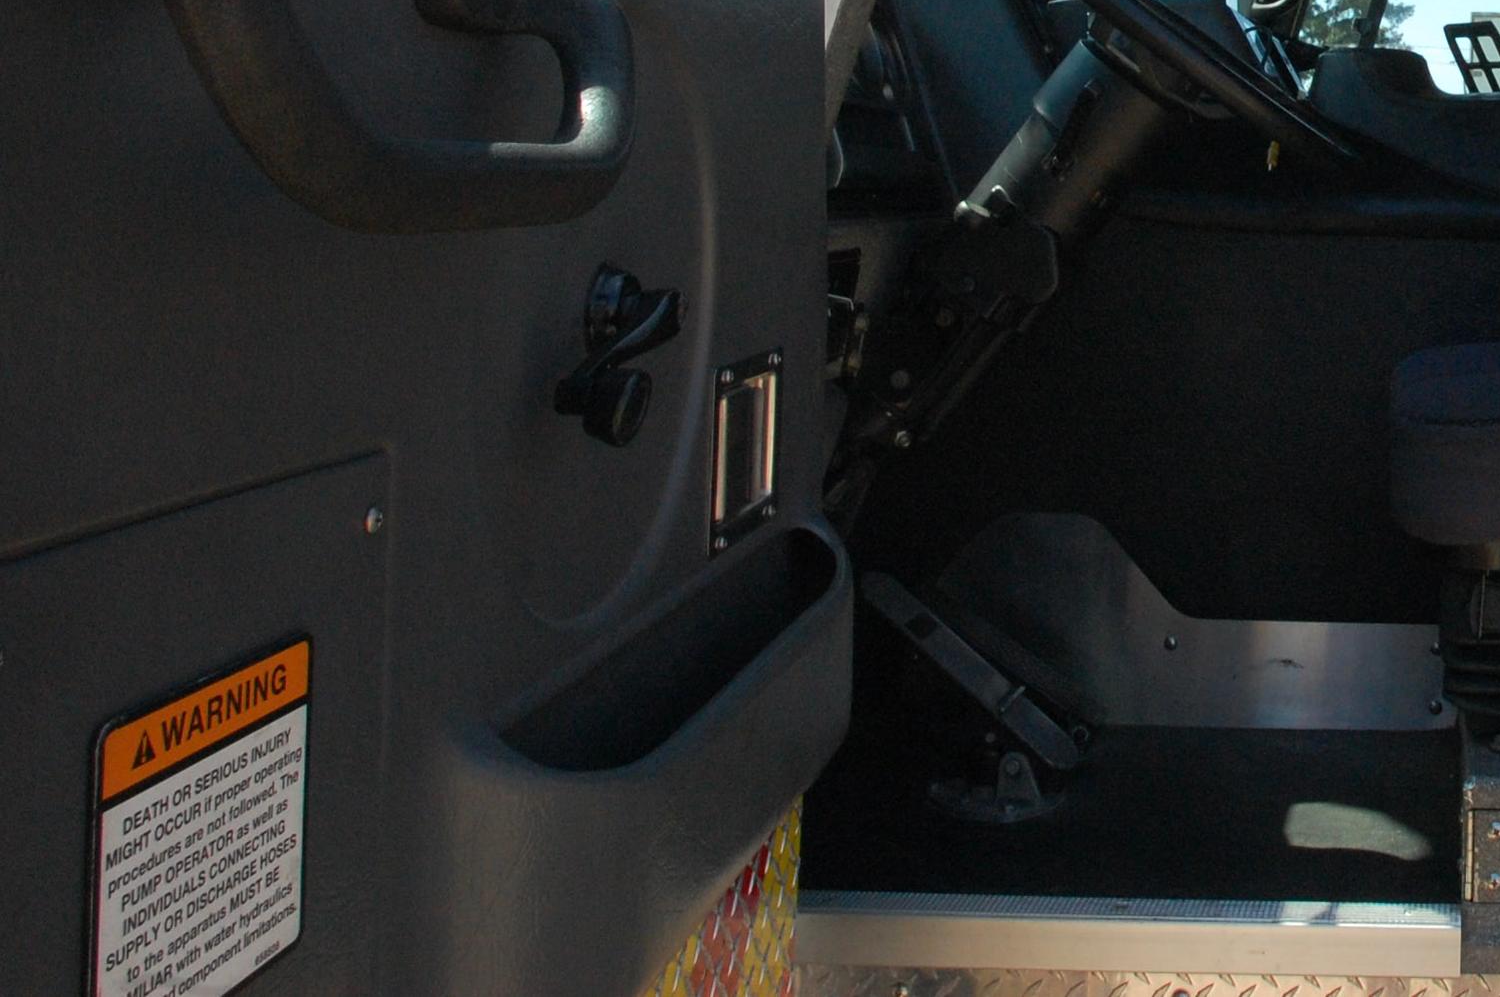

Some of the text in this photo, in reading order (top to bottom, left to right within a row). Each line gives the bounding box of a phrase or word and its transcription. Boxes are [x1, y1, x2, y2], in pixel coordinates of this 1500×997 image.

[162, 664, 286, 751] WARNING
[106, 747, 302, 871] MIGHT OCCUR if proper operating
[108, 771, 298, 899] procedures are not followed. The
[123, 728, 291, 835] DEATH OR SERIOUS INJURY
[106, 834, 296, 972] SUPPLY OR DISCHARGE HOSES
[122, 799, 288, 912] PUMP OPERATOR as well as
[123, 820, 285, 936] INDIVIDUALS CONNECTING
[127, 866, 279, 983] to the apparatus MUST BE
[176, 946, 201, 972] with
[204, 922, 236, 952] water
[239, 883, 292, 928] hydraulics
[178, 939, 241, 995] component
[243, 903, 297, 948] limitations.
[255, 941, 279, 966] N
